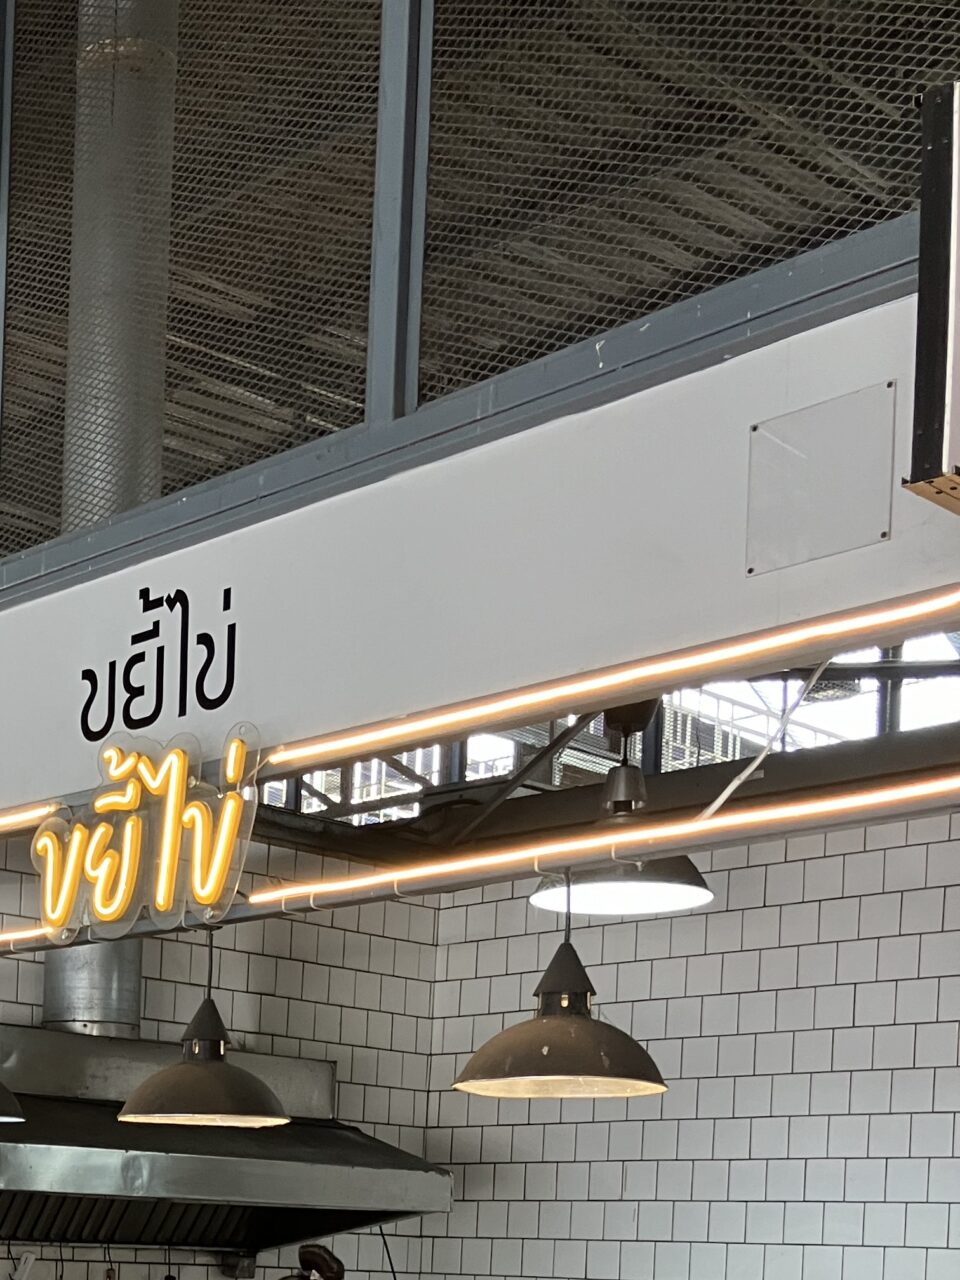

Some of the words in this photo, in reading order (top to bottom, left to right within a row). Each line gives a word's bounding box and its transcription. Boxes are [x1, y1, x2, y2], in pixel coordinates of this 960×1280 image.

[81, 587, 236, 742] ขยี้ไข่
[37, 736, 246, 927] ขยี้ไข่
